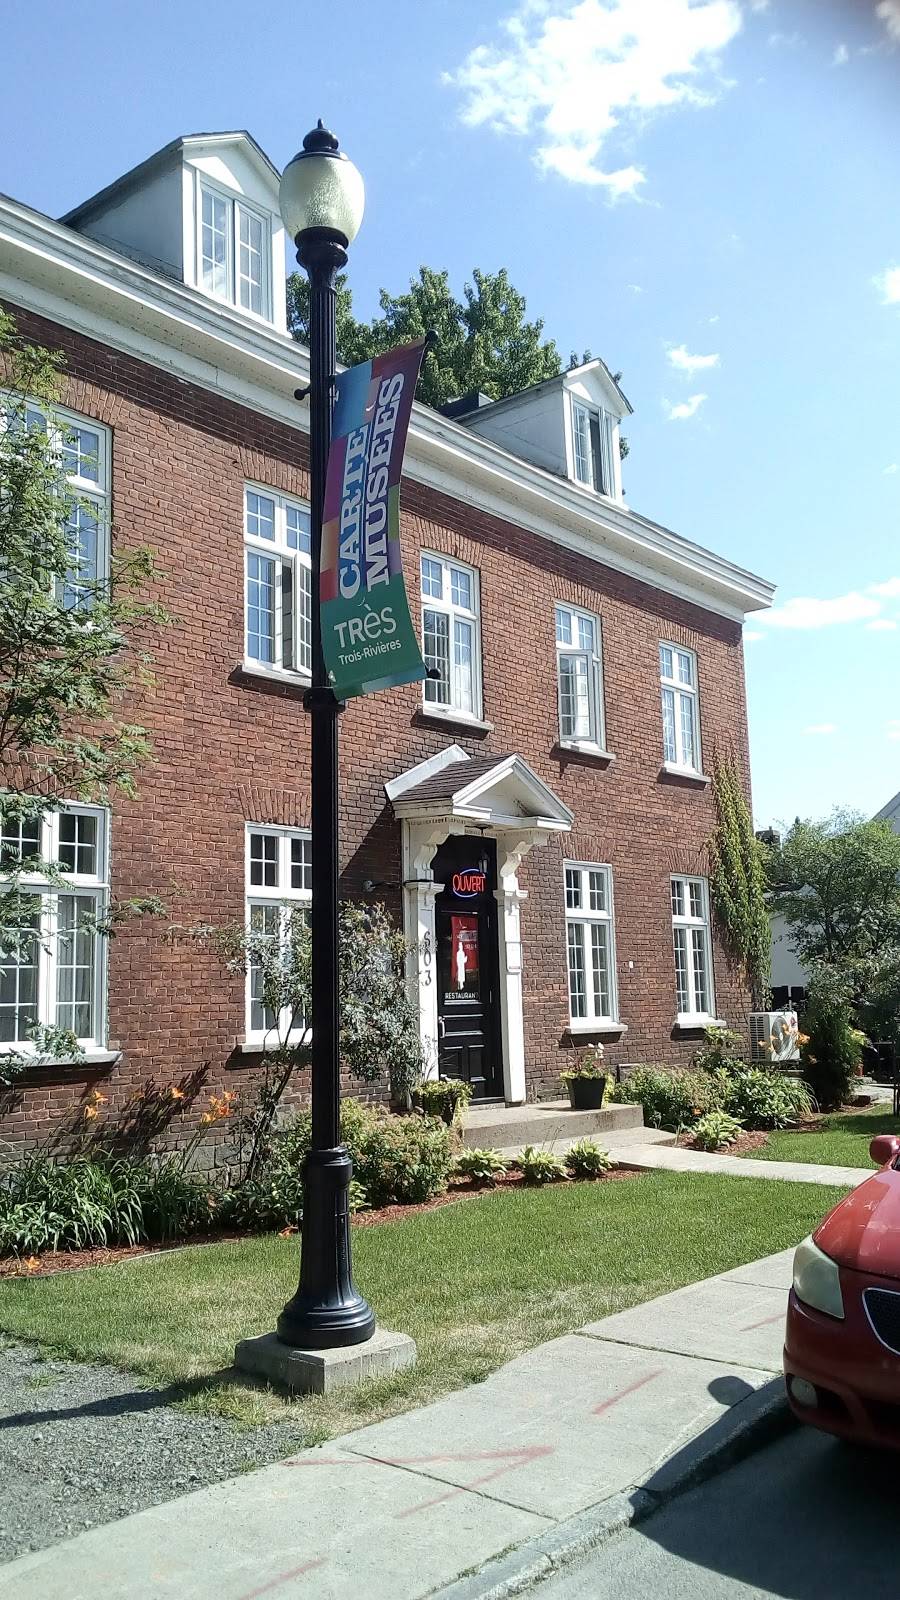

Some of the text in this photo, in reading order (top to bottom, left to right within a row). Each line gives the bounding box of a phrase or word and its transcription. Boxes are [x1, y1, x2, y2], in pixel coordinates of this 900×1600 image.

[339, 424, 369, 599] CARTE
[338, 640, 402, 665] Trois-Rivières
[452, 873, 486, 892] OUVERT
